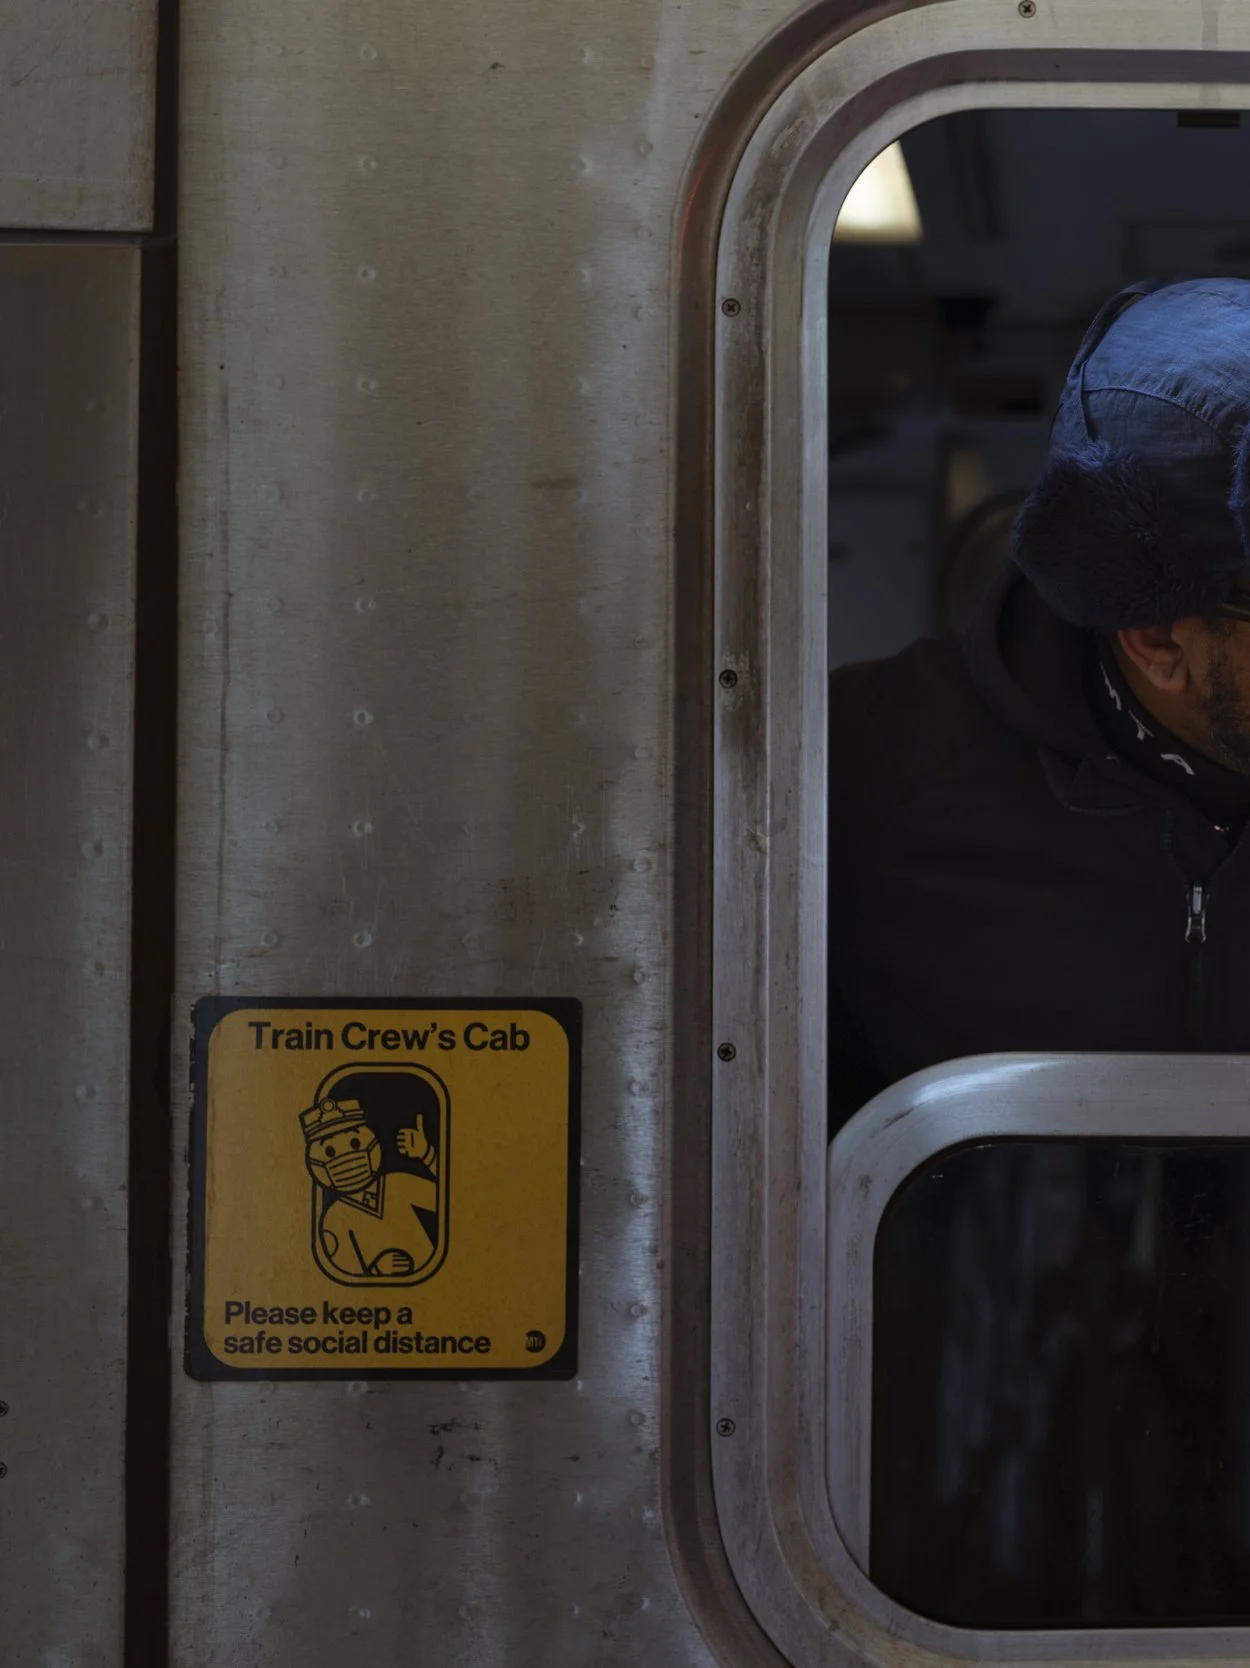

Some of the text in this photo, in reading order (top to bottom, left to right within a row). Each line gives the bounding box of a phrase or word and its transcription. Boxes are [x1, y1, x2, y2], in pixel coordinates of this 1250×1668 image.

[248, 1021, 531, 1051] Train Crew’s Cab
[224, 1301, 412, 1329] Please keep a
[224, 1330, 491, 1355] safe social distance
